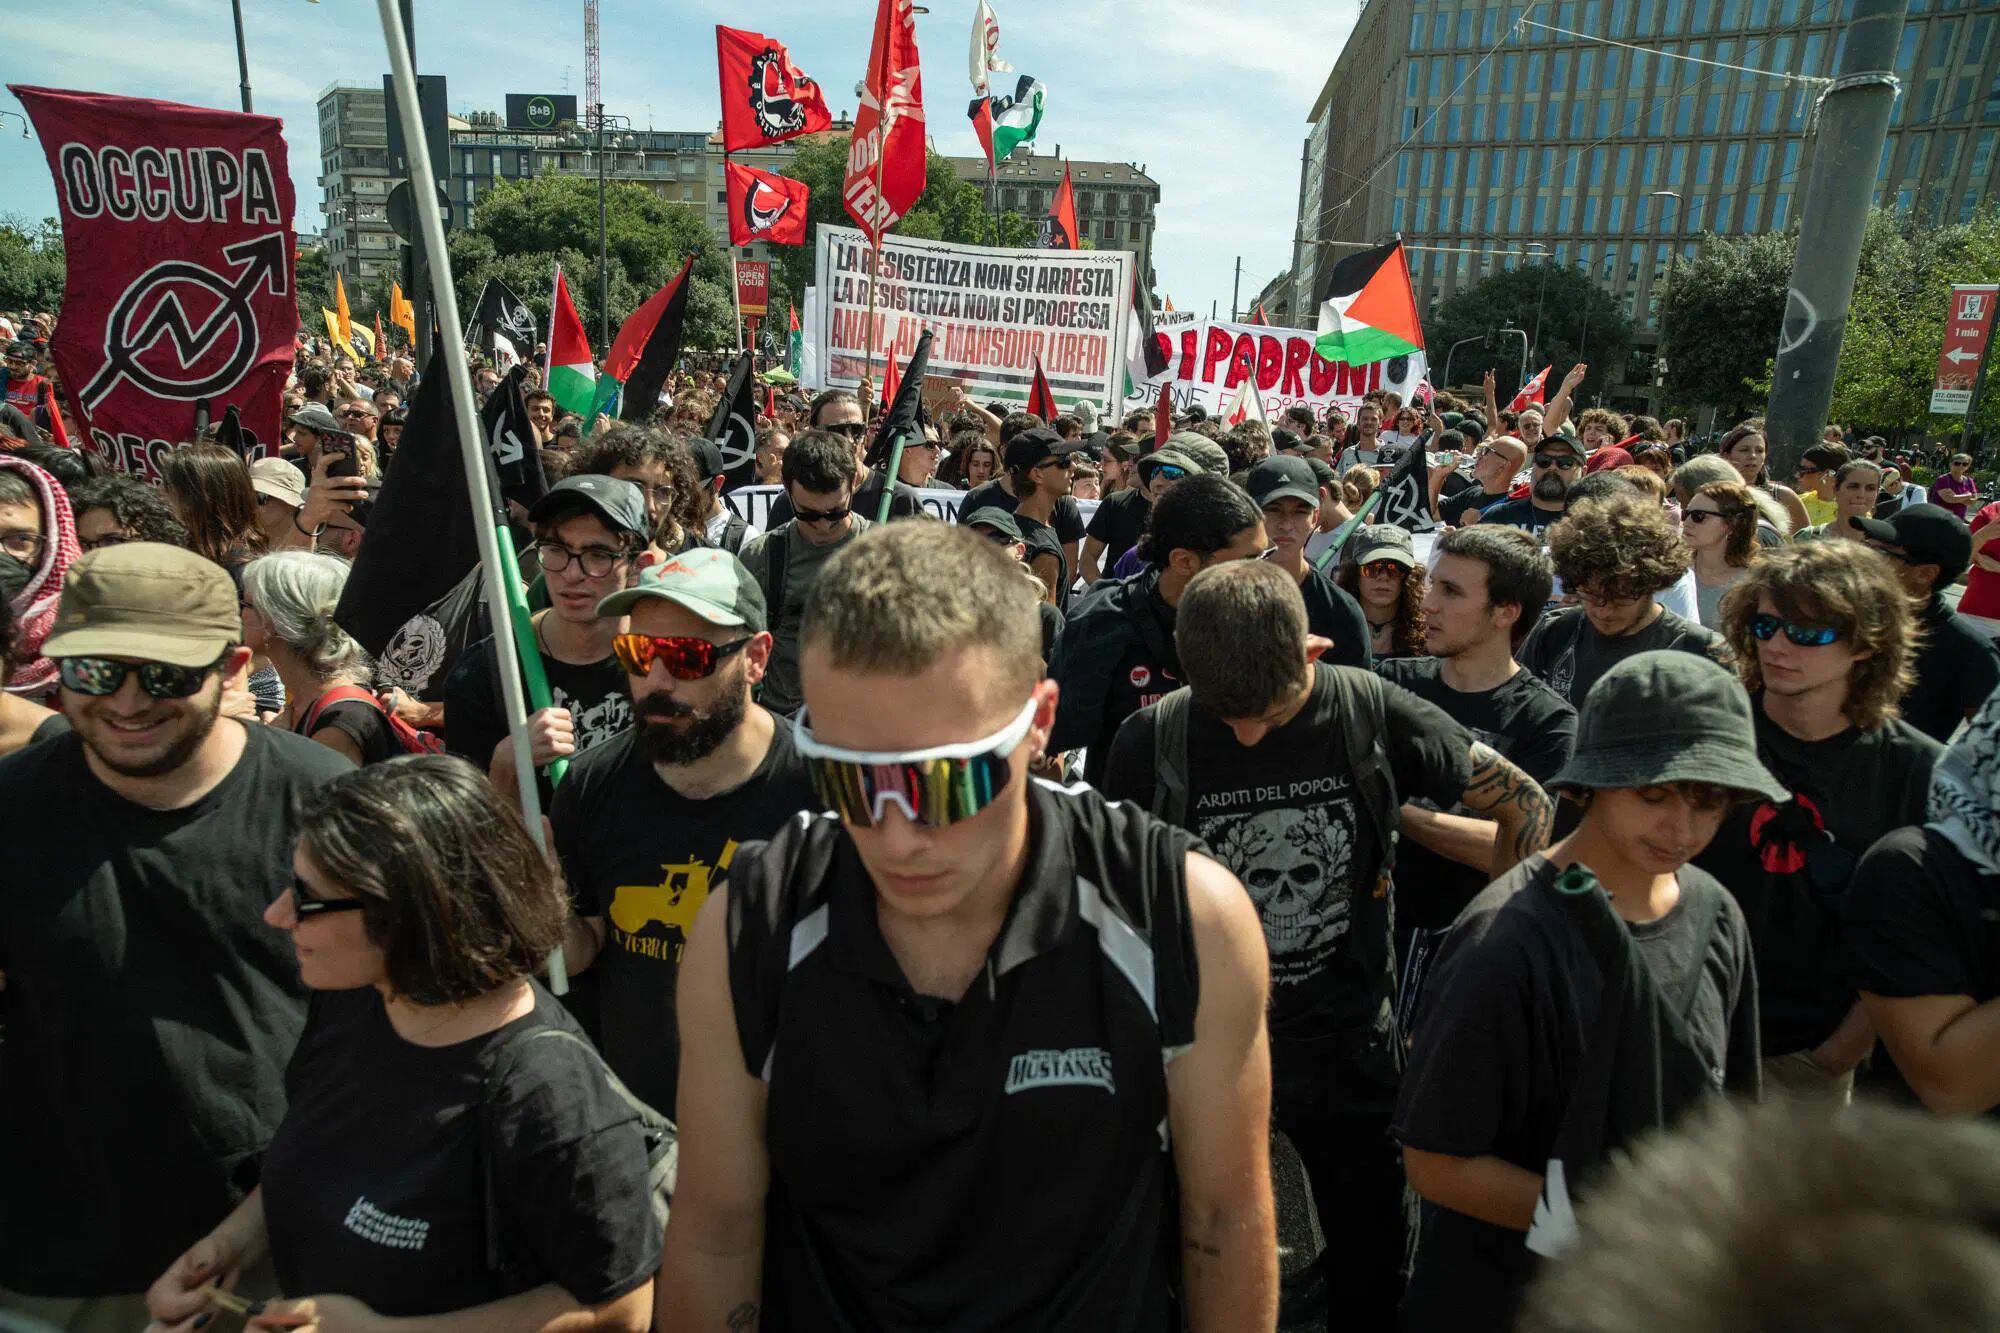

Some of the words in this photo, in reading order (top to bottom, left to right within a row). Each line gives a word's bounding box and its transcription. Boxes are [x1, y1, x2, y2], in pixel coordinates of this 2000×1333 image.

[529, 105, 551, 117] B&B
[58, 142, 281, 225] OCCUPA
[738, 271, 765, 280] OPEN
[739, 278, 764, 287] TOUR
[836, 243, 858, 273] LA
[861, 247, 971, 288] RESISTENZA
[974, 262, 1014, 292] NON
[1015, 265, 1035, 293] SI
[1036, 266, 1113, 297] ARRESTA
[833, 276, 853, 304] LA
[856, 279, 961, 318] RESISTENZA
[963, 293, 1001, 322] NON
[1002, 296, 1022, 323] SI
[1022, 298, 1110, 330] PROCESSA
[831, 307, 890, 357] ANAN,
[944, 322, 1045, 371] MANSOUR
[1046, 331, 1108, 377] LIBERI
[1955, 327, 1961, 337] 1
[1960, 327, 1979, 337] min
[1202, 326, 1381, 398] PADRONI
[1196, 789, 1251, 809] ARDITI
[1256, 785, 1286, 802] DEL
[1010, 1053, 1114, 1088] MUSTANGS
